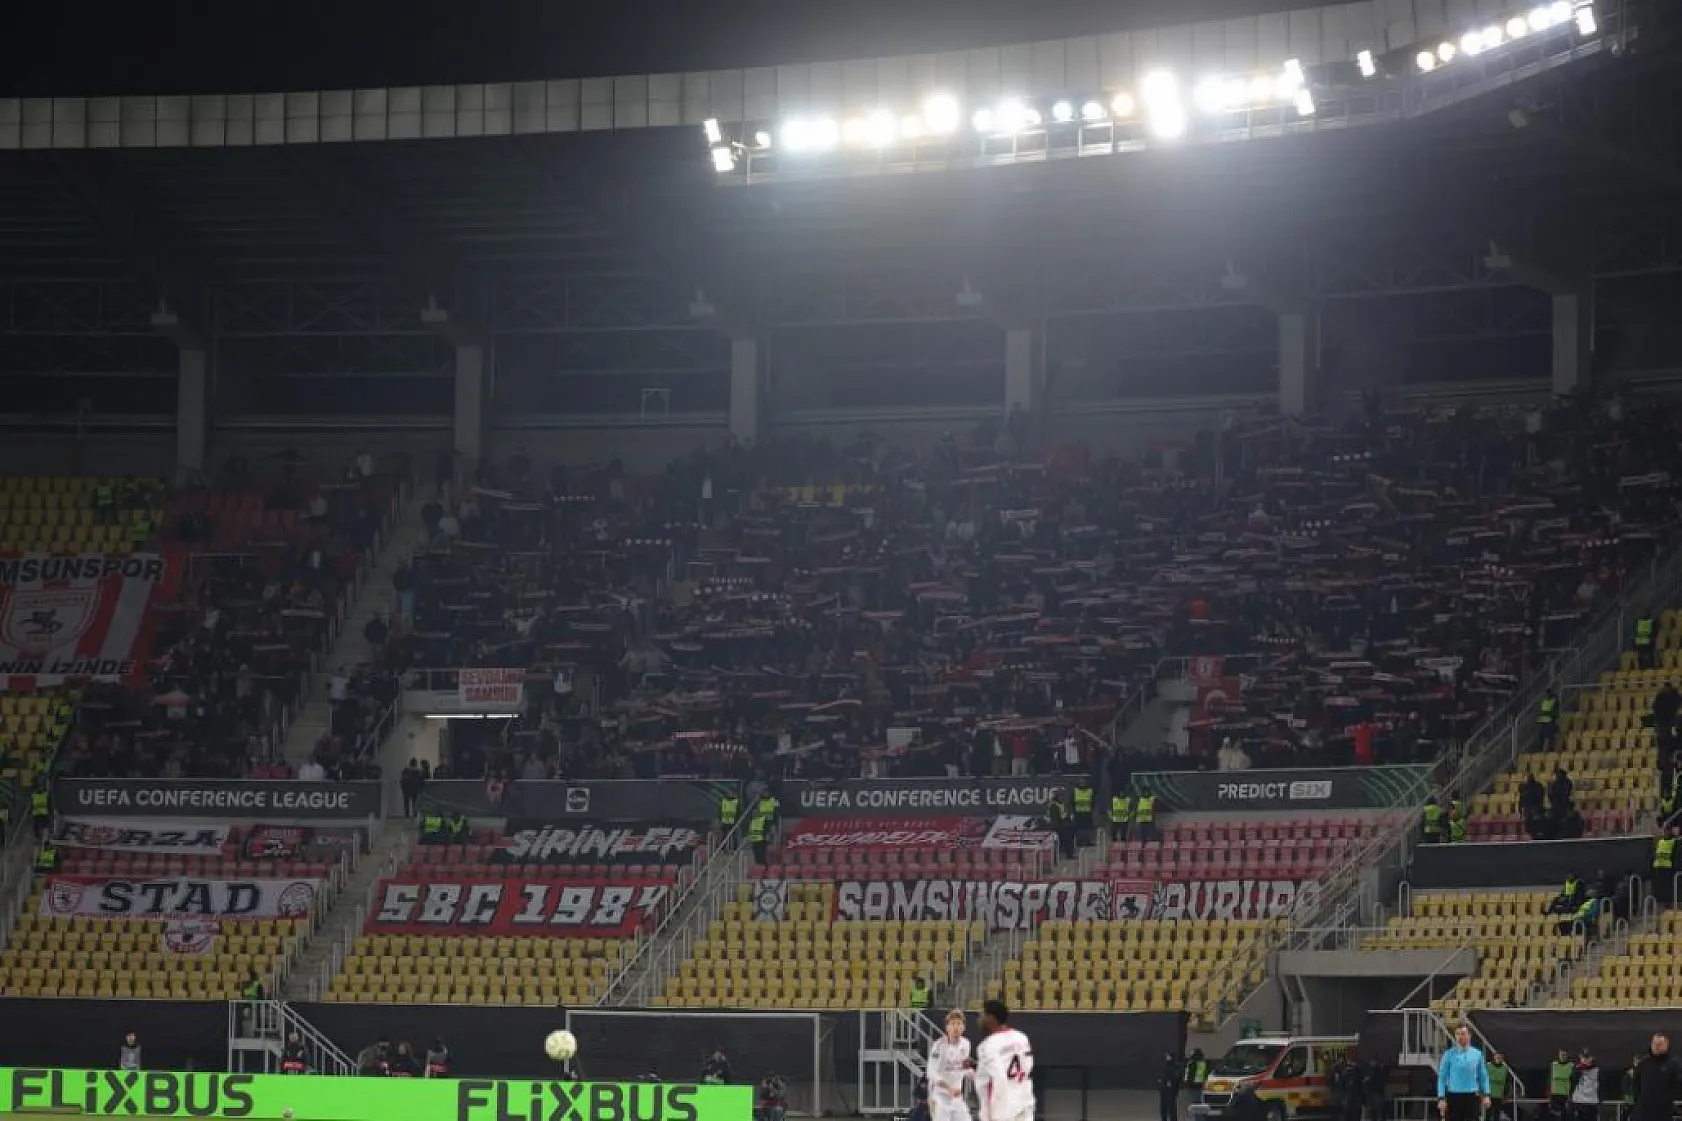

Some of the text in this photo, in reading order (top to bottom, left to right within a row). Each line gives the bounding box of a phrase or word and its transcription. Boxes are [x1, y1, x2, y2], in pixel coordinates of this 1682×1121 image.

[79, 789, 349, 809] UEFA CONFERENCE LEAGUE
[801, 790, 851, 808] UEFA
[856, 788, 982, 807] CONFERENCE
[1218, 782, 1288, 799] PREDICT
[98, 882, 261, 914] STAD
[839, 880, 1108, 928] SAMSUNSPOR
